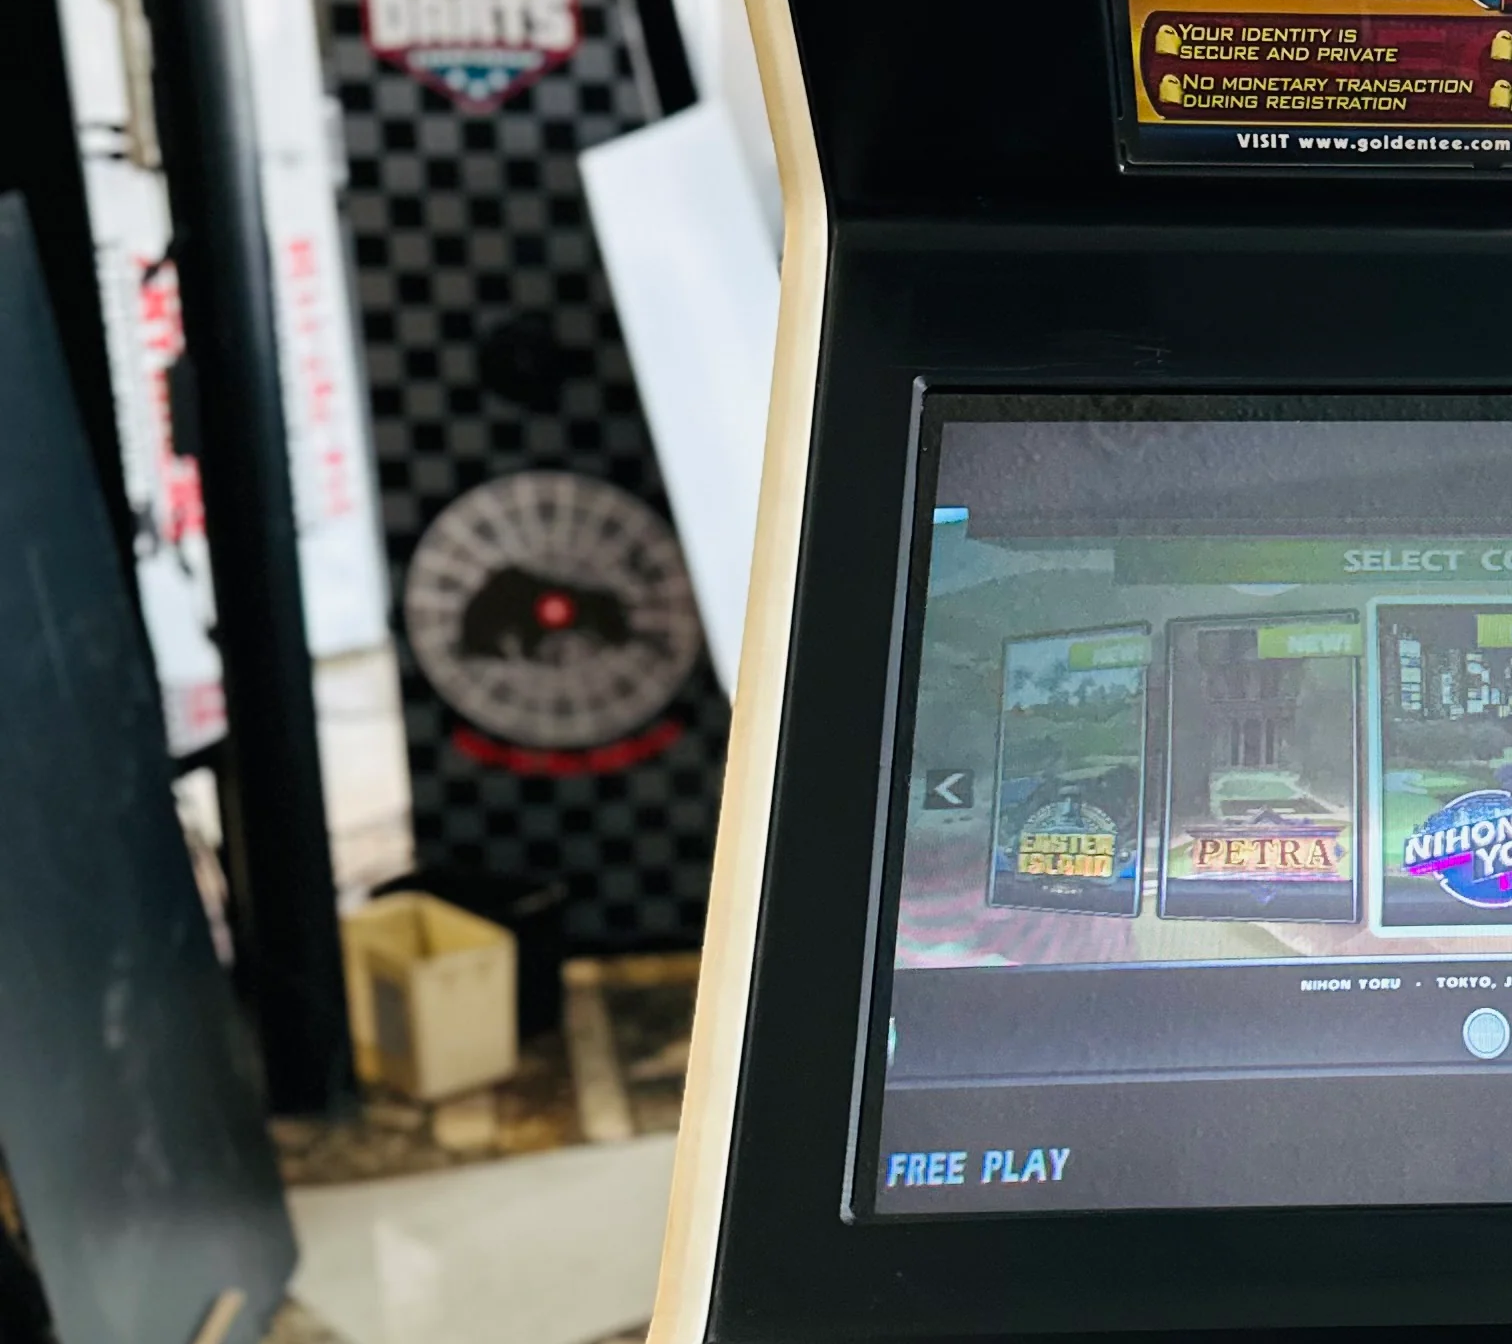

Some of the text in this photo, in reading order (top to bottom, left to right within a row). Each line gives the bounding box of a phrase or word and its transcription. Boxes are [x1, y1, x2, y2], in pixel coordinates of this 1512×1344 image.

[1179, 23, 1357, 43] YOUR IDENTITY IS
[1179, 45, 1399, 63] SECURE AND PRIVATE
[1182, 73, 1474, 94] NO MONETARY TRANSACTION
[1183, 94, 1407, 111] DURING REGISTRATION
[1236, 134, 1289, 149] VISIT
[1299, 134, 1511, 153] www.goldentee.com
[1344, 549, 1463, 573] SELECT
[1193, 837, 1335, 870] PETRA
[887, 1147, 1071, 1187] FREE PLAY
